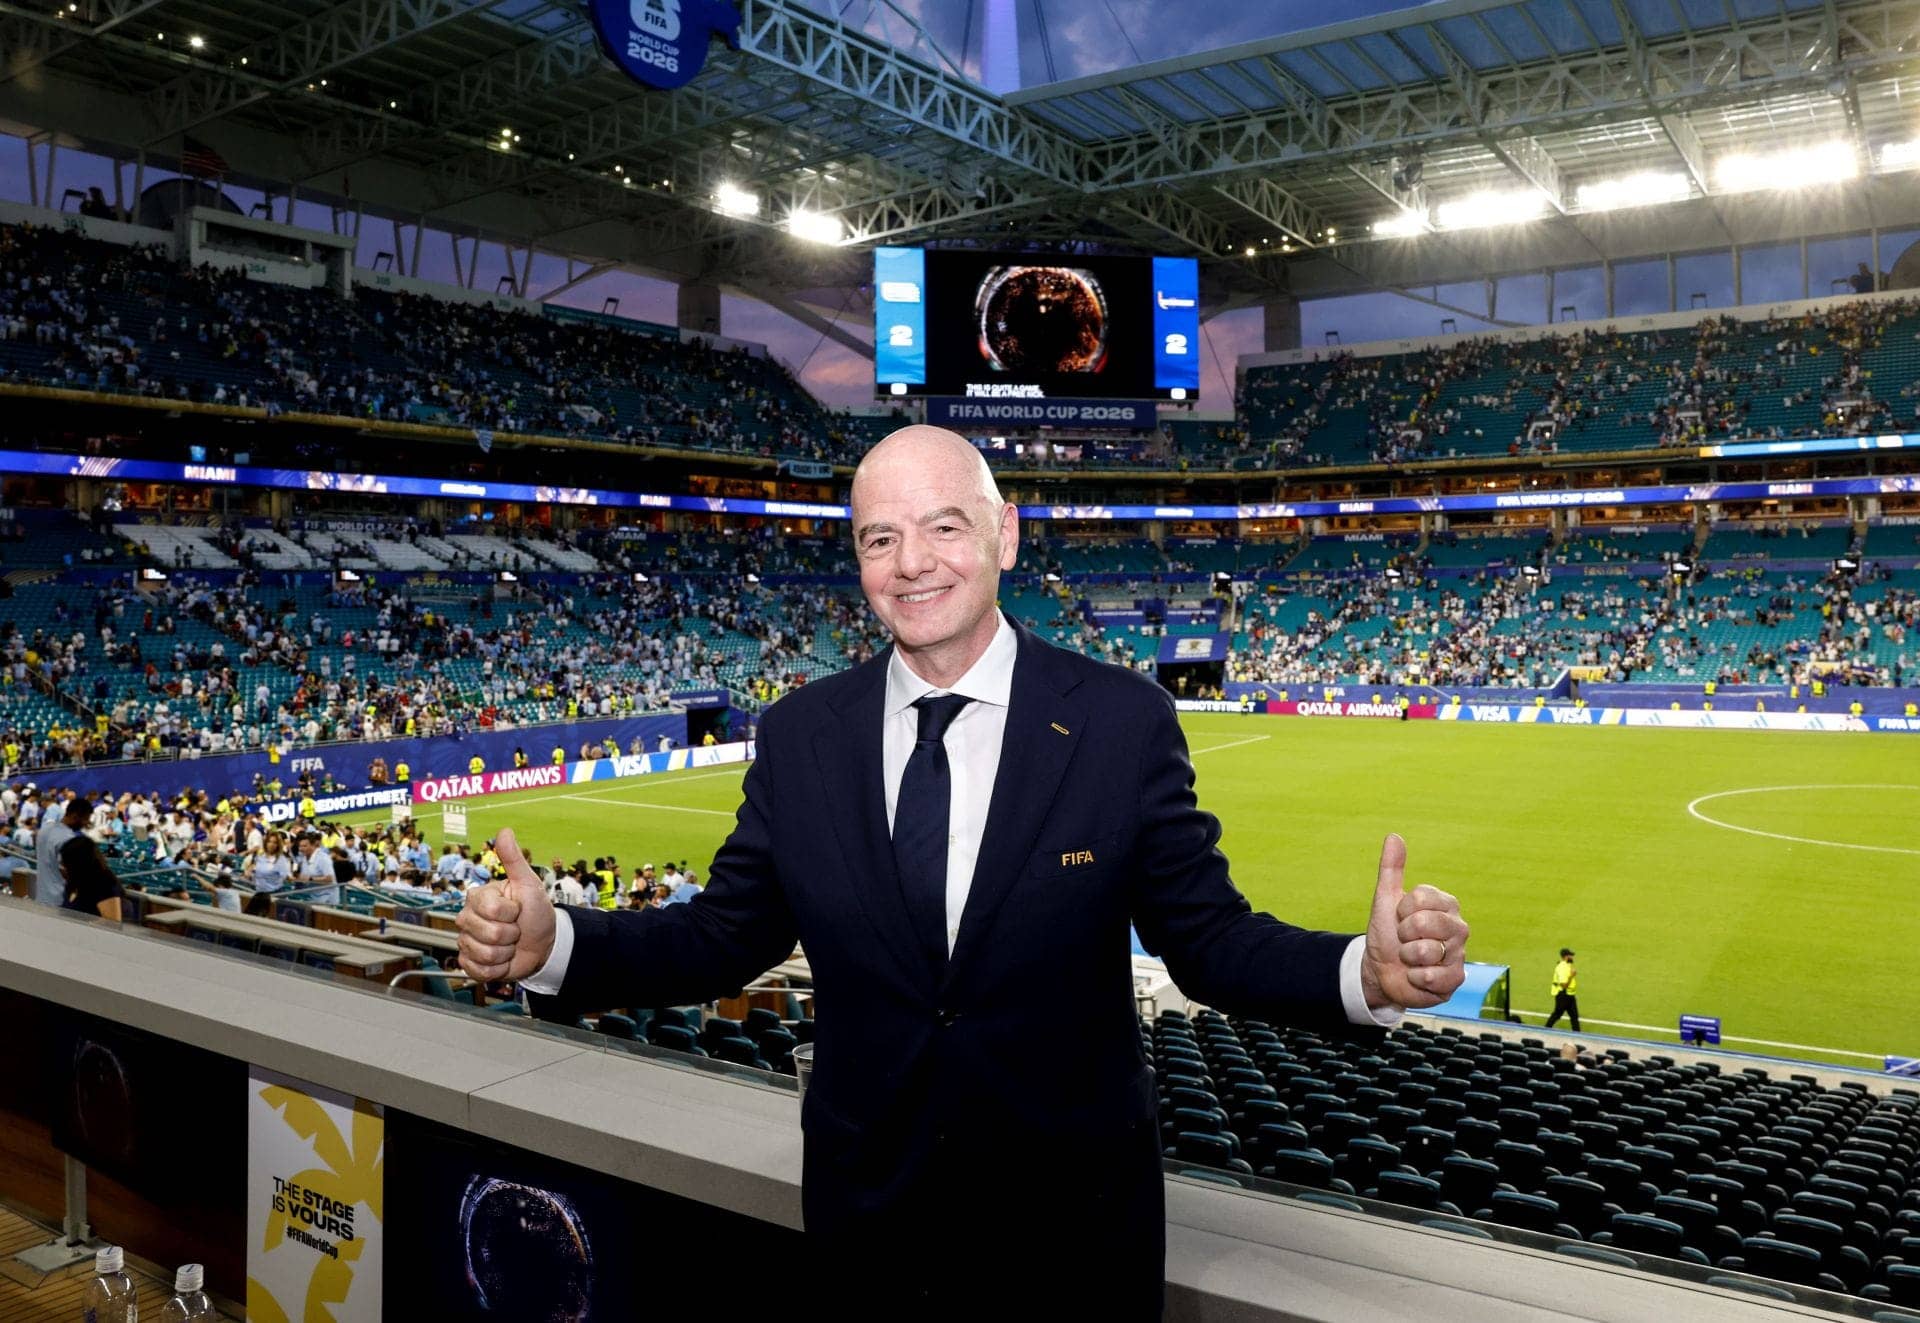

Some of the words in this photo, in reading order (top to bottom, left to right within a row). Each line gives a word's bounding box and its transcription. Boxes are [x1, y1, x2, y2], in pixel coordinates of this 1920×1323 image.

[645, 11, 667, 29] FIFA
[629, 30, 661, 50] WORLD
[662, 43, 680, 57] CUP
[627, 41, 679, 73] 2026
[889, 325, 913, 346] 2
[1165, 334, 1188, 354] 2
[949, 404, 984, 418] FIFA
[986, 404, 1044, 419] WORLD
[1046, 406, 1079, 419] CUP
[1080, 406, 1136, 420] 2026
[184, 465, 236, 481] MIAMI
[1768, 483, 1813, 495] MIAMI
[1339, 502, 1374, 513] MIAMI
[327, 520, 363, 531] WORLD
[1344, 534, 1384, 542] MIAMI
[1297, 702, 1342, 716] QATAR
[1346, 702, 1403, 717] AIRWAYS
[1469, 705, 1511, 722] VISA
[1550, 707, 1593, 724] VISA
[291, 757, 324, 773] FIFA
[609, 753, 652, 777] VISA
[420, 775, 484, 802] QATAR
[490, 766, 561, 792] AIRWAYS
[259, 801, 295, 823] ADI
[1061, 850, 1094, 866] FIFA
[272, 1176, 300, 1201] THE
[302, 1188, 354, 1223] STAGE
[272, 1194, 285, 1213] IS
[288, 1200, 354, 1242] YOURS
[286, 1225, 338, 1260] #FIFAWorldCup
